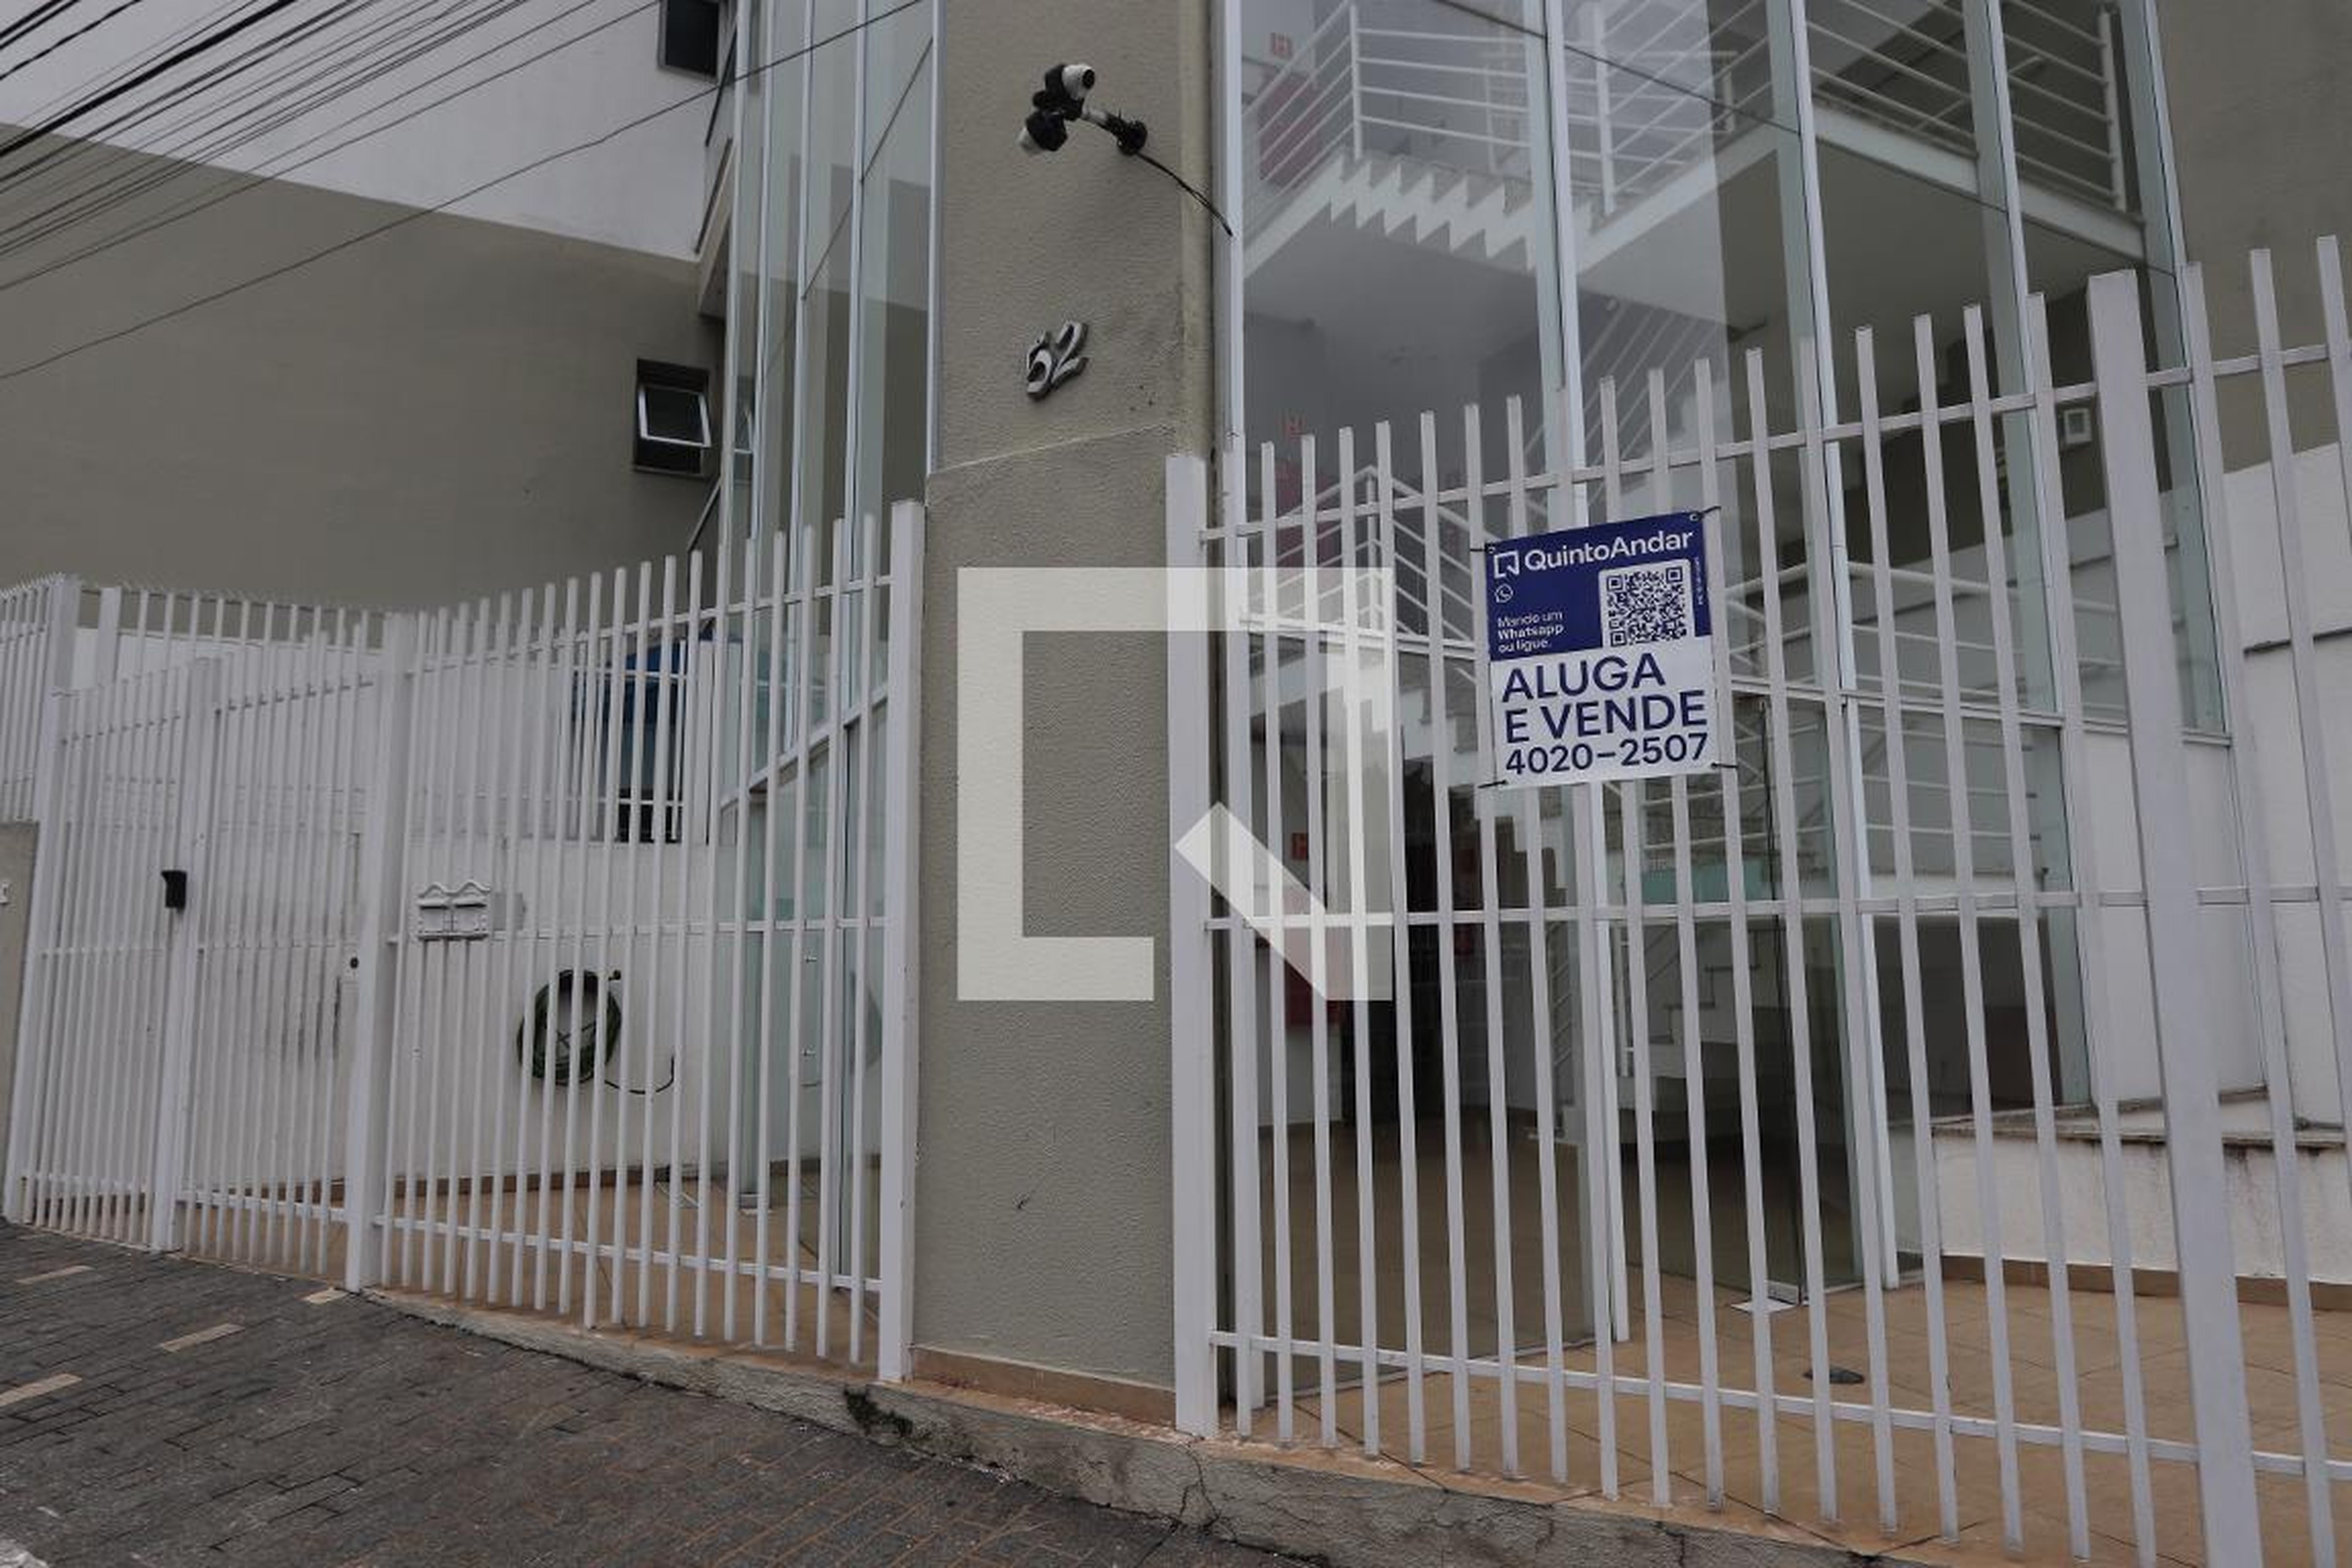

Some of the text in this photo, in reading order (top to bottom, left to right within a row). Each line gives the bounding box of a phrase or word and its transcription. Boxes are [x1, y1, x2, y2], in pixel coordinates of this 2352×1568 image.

[1524, 530, 1693, 571] QuintoAndar
[1542, 611, 1562, 621] um
[1498, 643, 1515, 654] ou
[1502, 653, 1666, 703] ALUGA
[1506, 690, 1708, 744] E VENDE
[1506, 733, 1708, 775] 4020-2507
